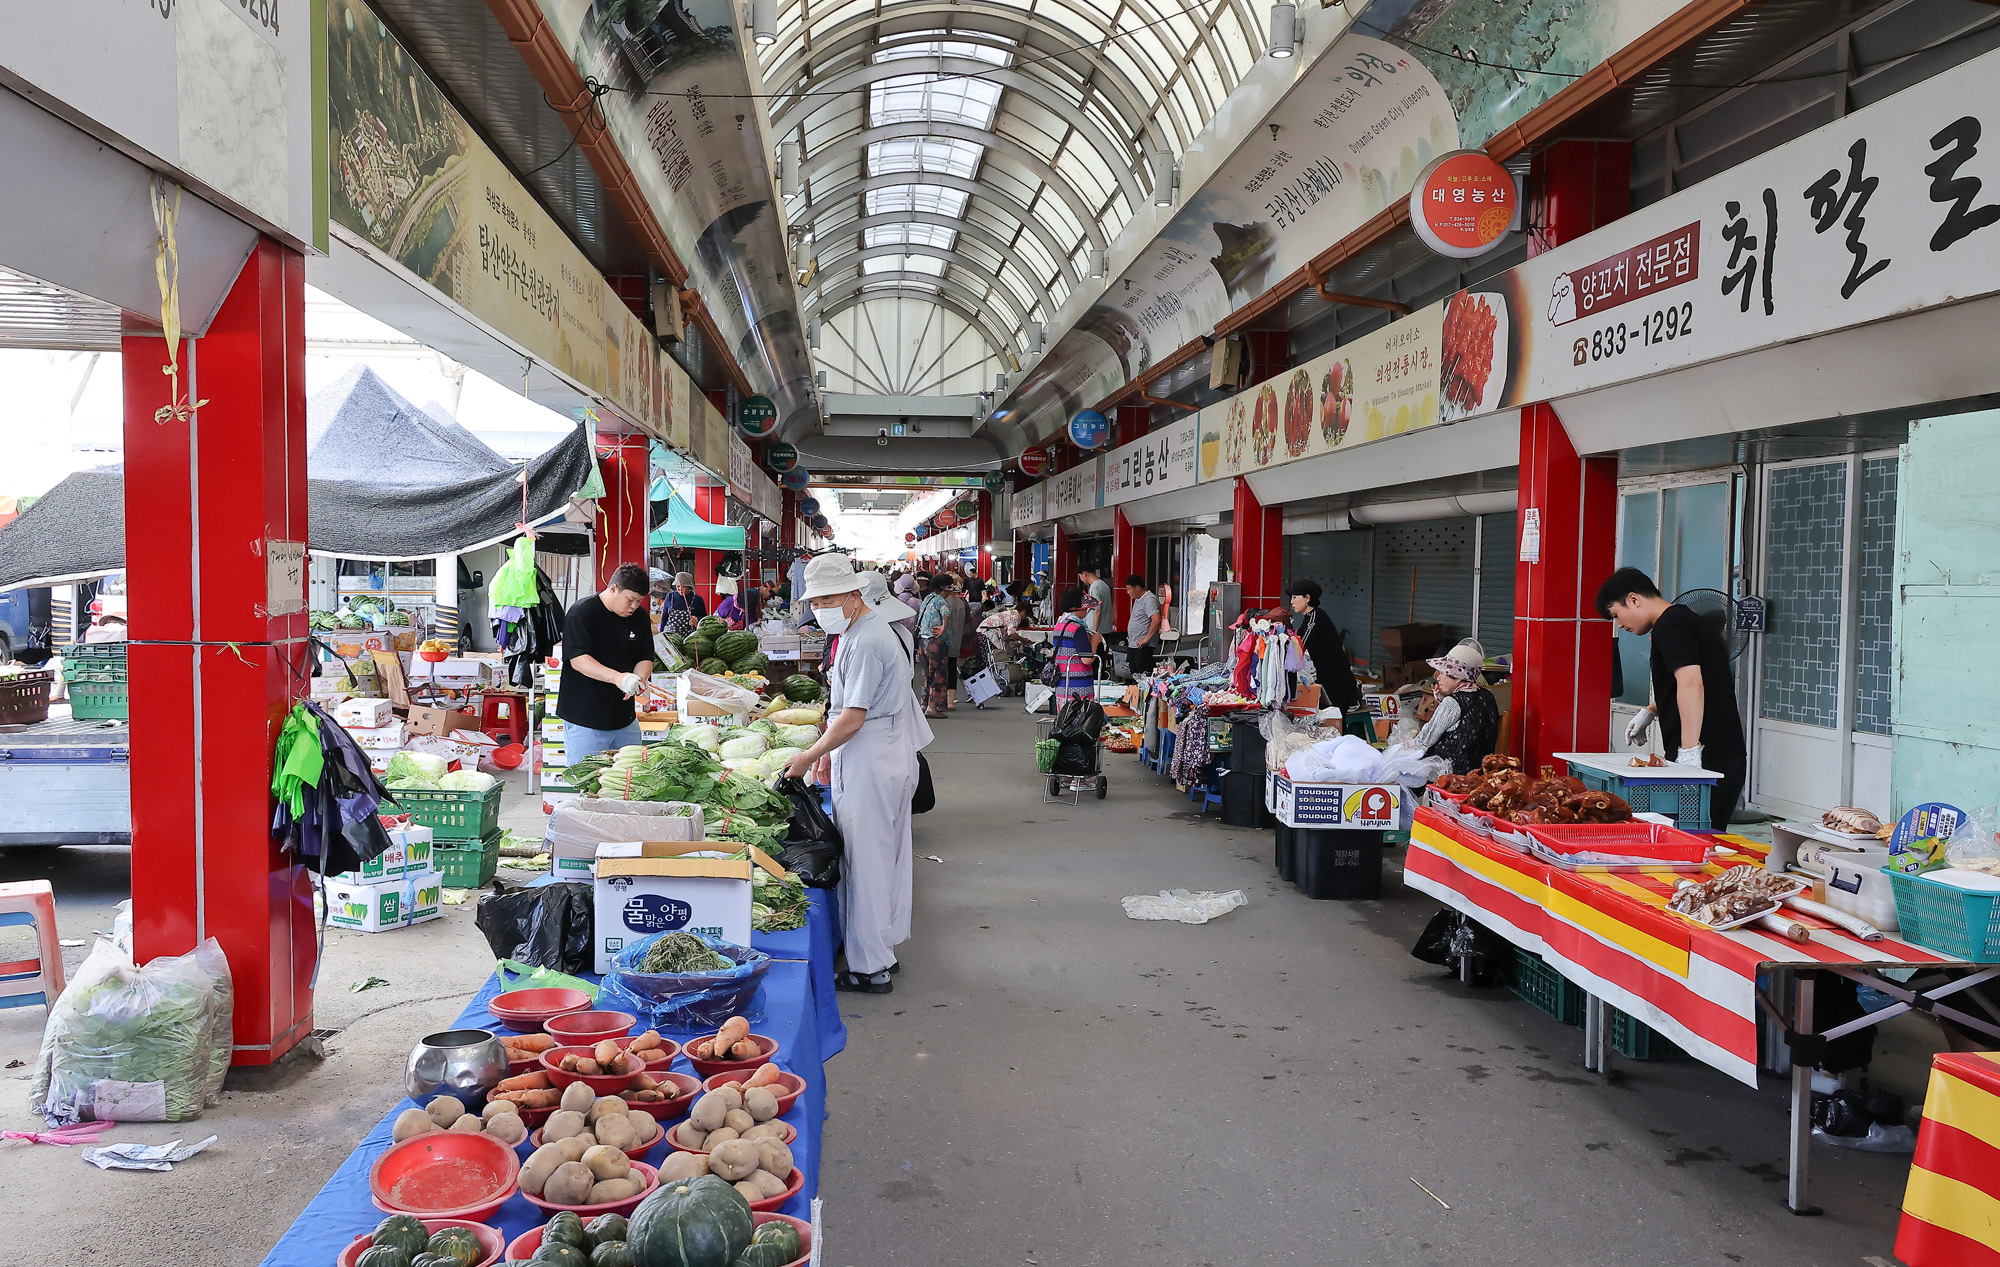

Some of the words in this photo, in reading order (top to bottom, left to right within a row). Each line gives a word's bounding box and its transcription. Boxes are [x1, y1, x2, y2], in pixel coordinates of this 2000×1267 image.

[1330, 87, 1362, 113] 전원도시
[1349, 131, 1374, 154] Dynamic
[1371, 117, 1391, 135] Green
[1388, 105, 1405, 120] City
[1400, 85, 1430, 109] Uiseong
[1432, 188, 1506, 203] 대영농산
[478, 223, 560, 329] 탑산약수온천관광지
[1581, 264, 1629, 311] 양꼬치
[1635, 233, 1692, 290] 전문점
[1386, 327, 1420, 353] 어서오이소
[1591, 301, 1694, 363] 833-1292
[1121, 436, 1169, 488] 그린농산
[1298, 805, 1338, 813] Bananas
[1299, 797, 1339, 805] Banaas
[1298, 813, 1338, 821] Bananas
[1360, 820, 1391, 828] unifrutti
[385, 851, 404, 863] 배추
[383, 899, 397, 913] 쌈
[623, 898, 649, 925] 물
[644, 913, 666, 929] 맑은
[660, 903, 688, 922] 양평
